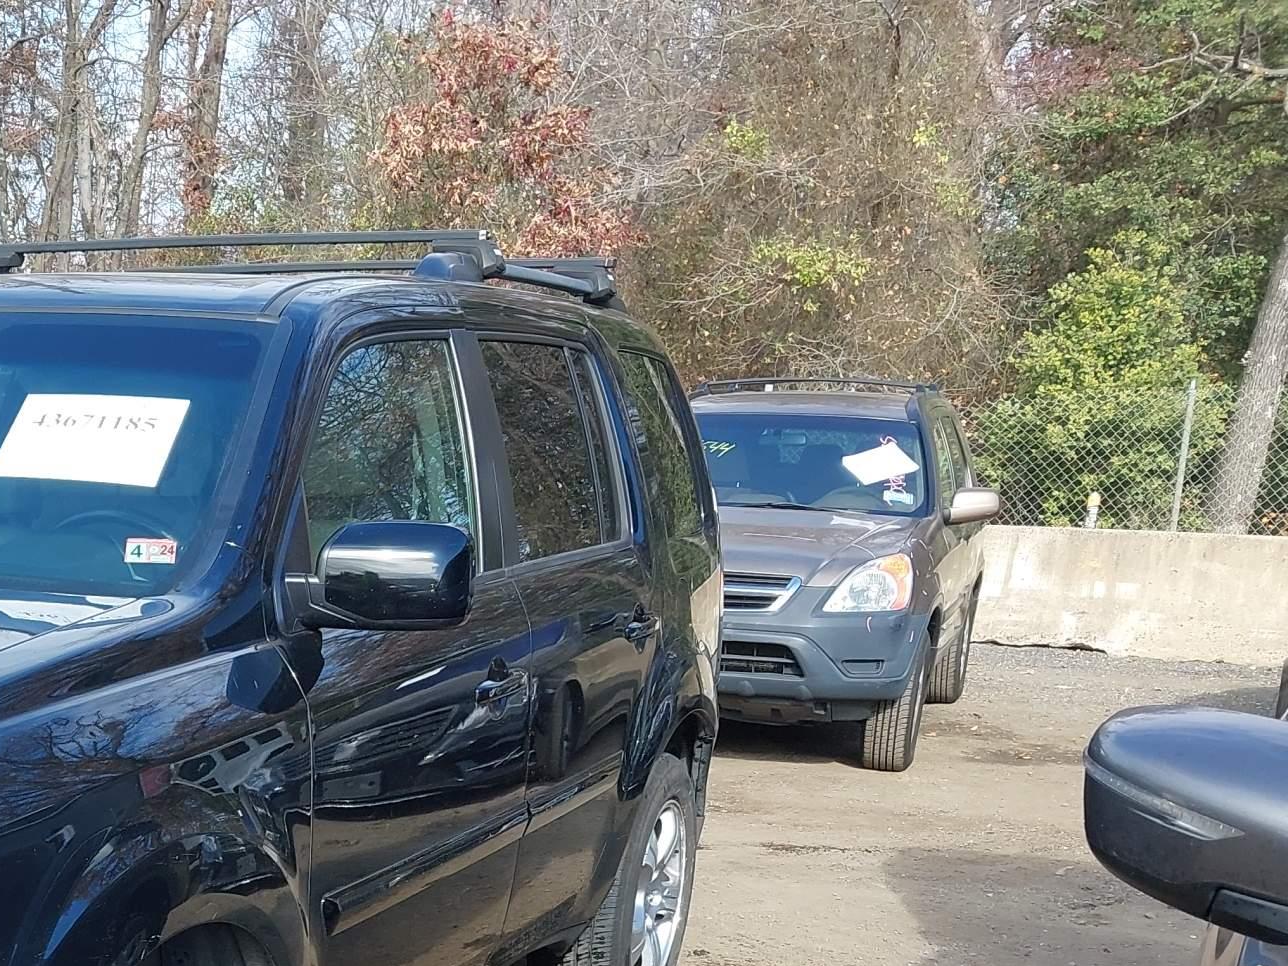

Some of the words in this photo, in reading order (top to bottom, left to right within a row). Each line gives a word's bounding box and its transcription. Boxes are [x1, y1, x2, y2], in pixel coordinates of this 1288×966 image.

[32, 411, 160, 433] 43671185
[129, 544, 143, 558] 4
[159, 544, 175, 556] 24
